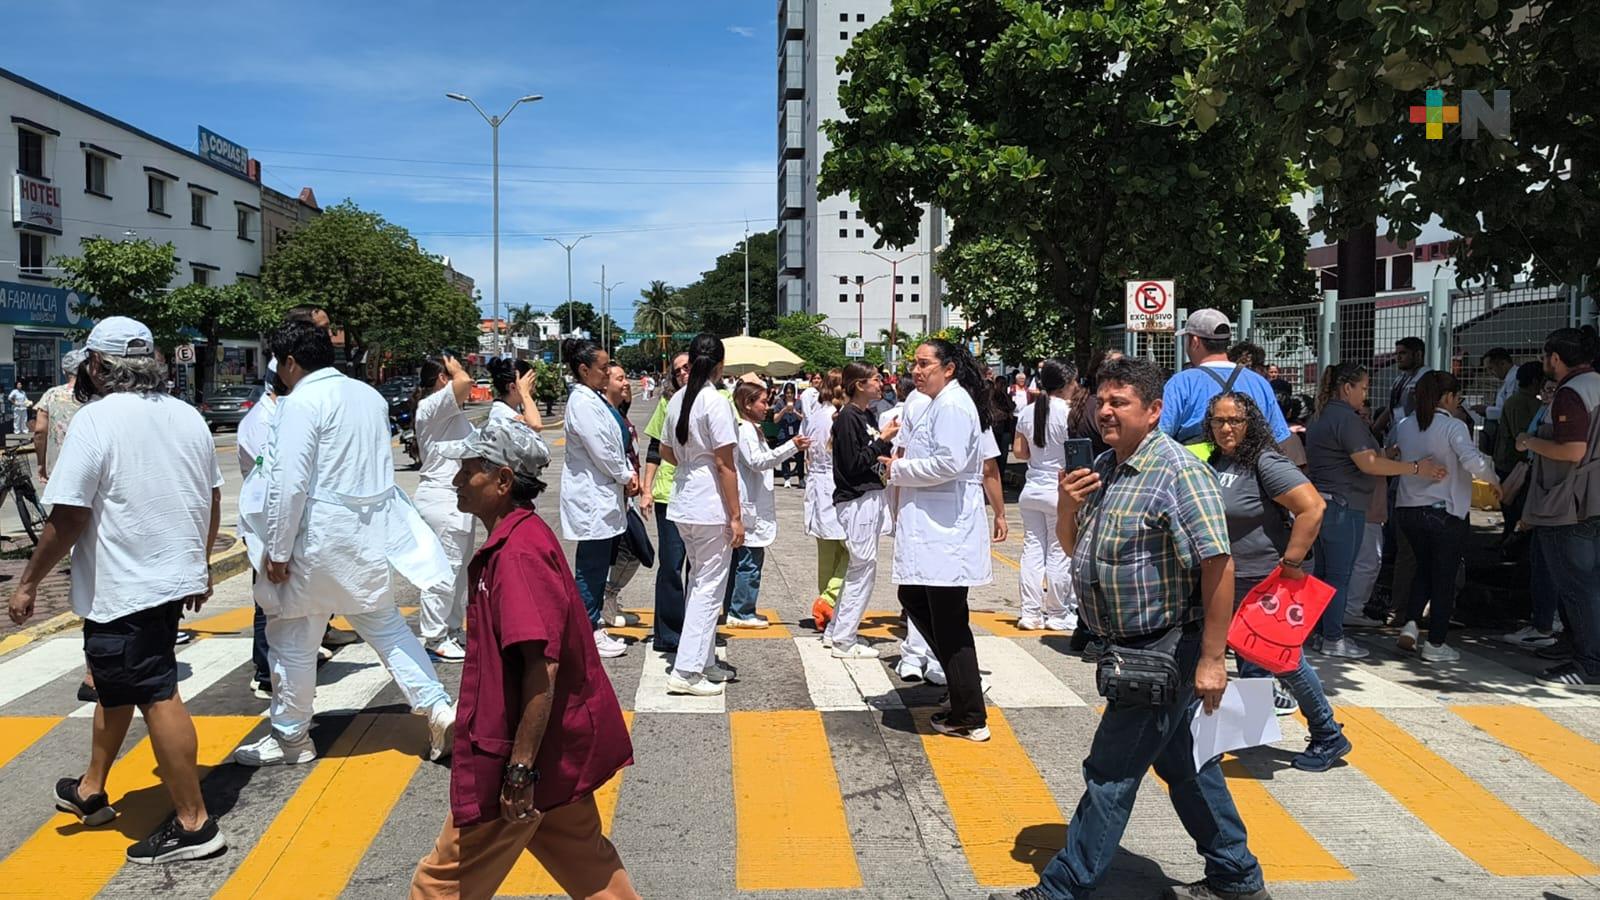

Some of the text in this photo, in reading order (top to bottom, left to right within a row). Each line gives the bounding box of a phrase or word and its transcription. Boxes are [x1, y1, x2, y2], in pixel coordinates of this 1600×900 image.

[210, 135, 241, 163] COPIAS
[21, 178, 60, 208] HOTEL
[7, 289, 58, 313] FARMACIA
[1130, 313, 1172, 321] EXCLUSIVO
[1141, 321, 1164, 329] TAXIS
[181, 349, 190, 359] E
